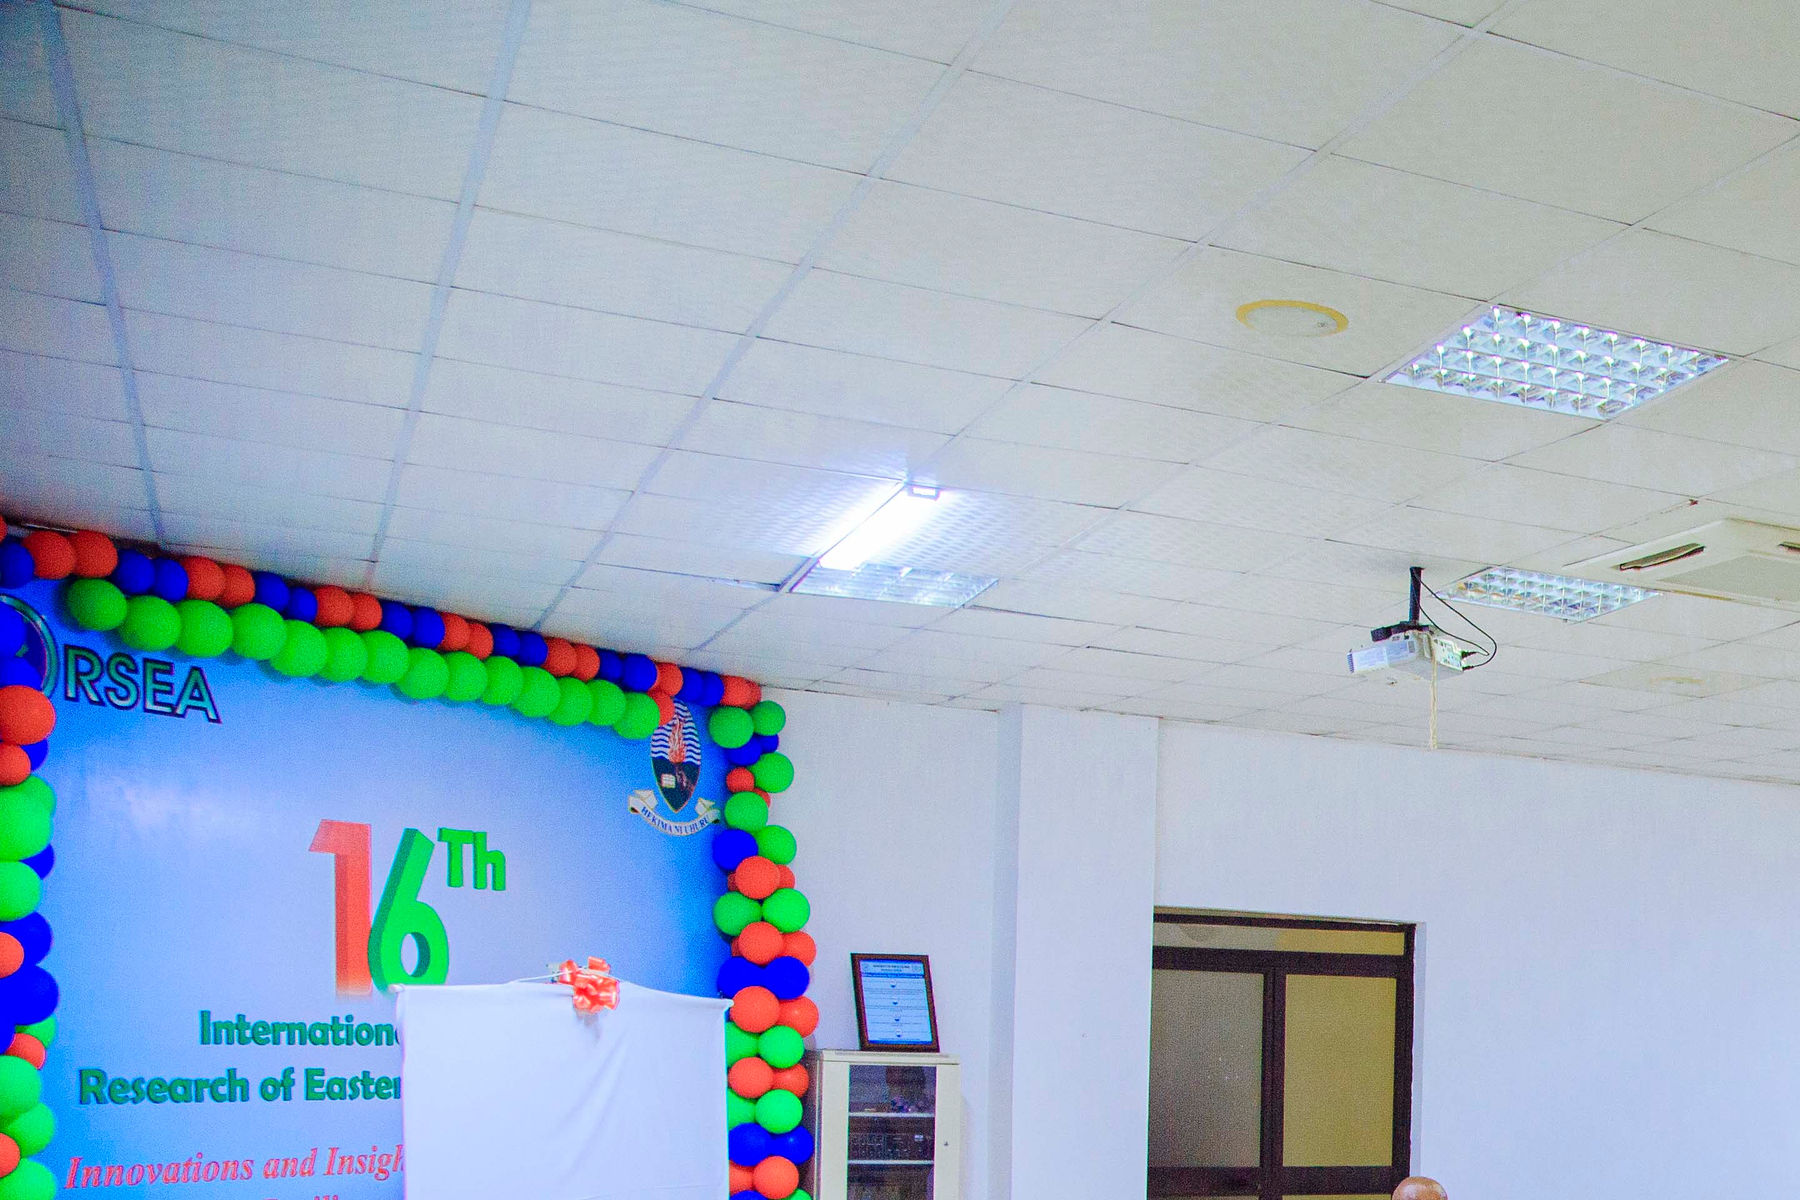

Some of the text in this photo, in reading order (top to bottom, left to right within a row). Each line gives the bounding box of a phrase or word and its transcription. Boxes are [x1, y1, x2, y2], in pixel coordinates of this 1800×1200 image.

[199, 1010, 400, 1046] Internation
[78, 1067, 250, 1105] Research
[260, 1066, 295, 1101] of
[64, 1152, 254, 1189] Innovations
[263, 1147, 318, 1178] and
